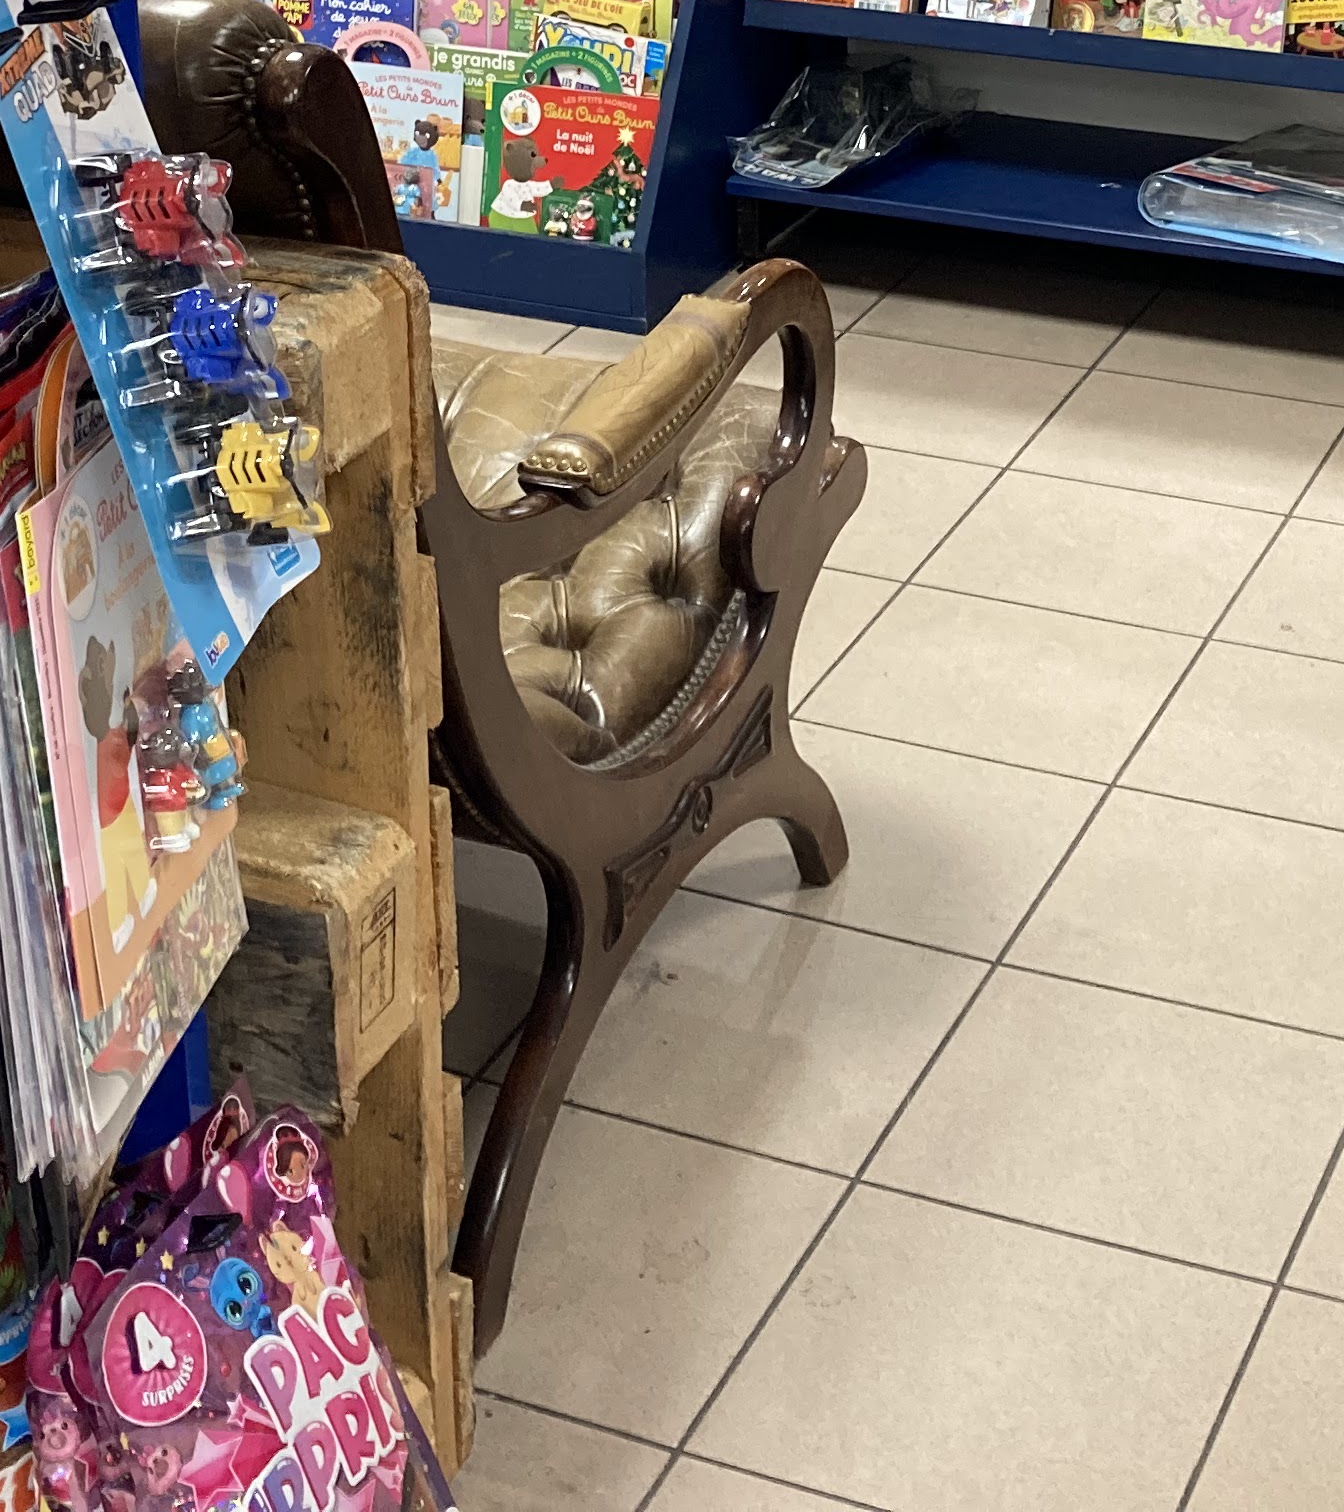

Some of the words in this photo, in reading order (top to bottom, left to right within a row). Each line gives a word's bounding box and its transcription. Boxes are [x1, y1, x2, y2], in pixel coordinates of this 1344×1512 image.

[432, 49, 449, 69] je
[451, 52, 516, 72] grandis
[14, 61, 56, 123] QUAD
[543, 101, 575, 120] Petit
[578, 104, 612, 126] Ours
[613, 110, 656, 130] Brun
[570, 130, 594, 143] nuit
[570, 142, 595, 156] Noël
[19, 514, 37, 569] bayard
[134, 1311, 176, 1373] 4
[246, 1286, 373, 1446] PAC
[141, 1354, 195, 1408] SURPRISES
